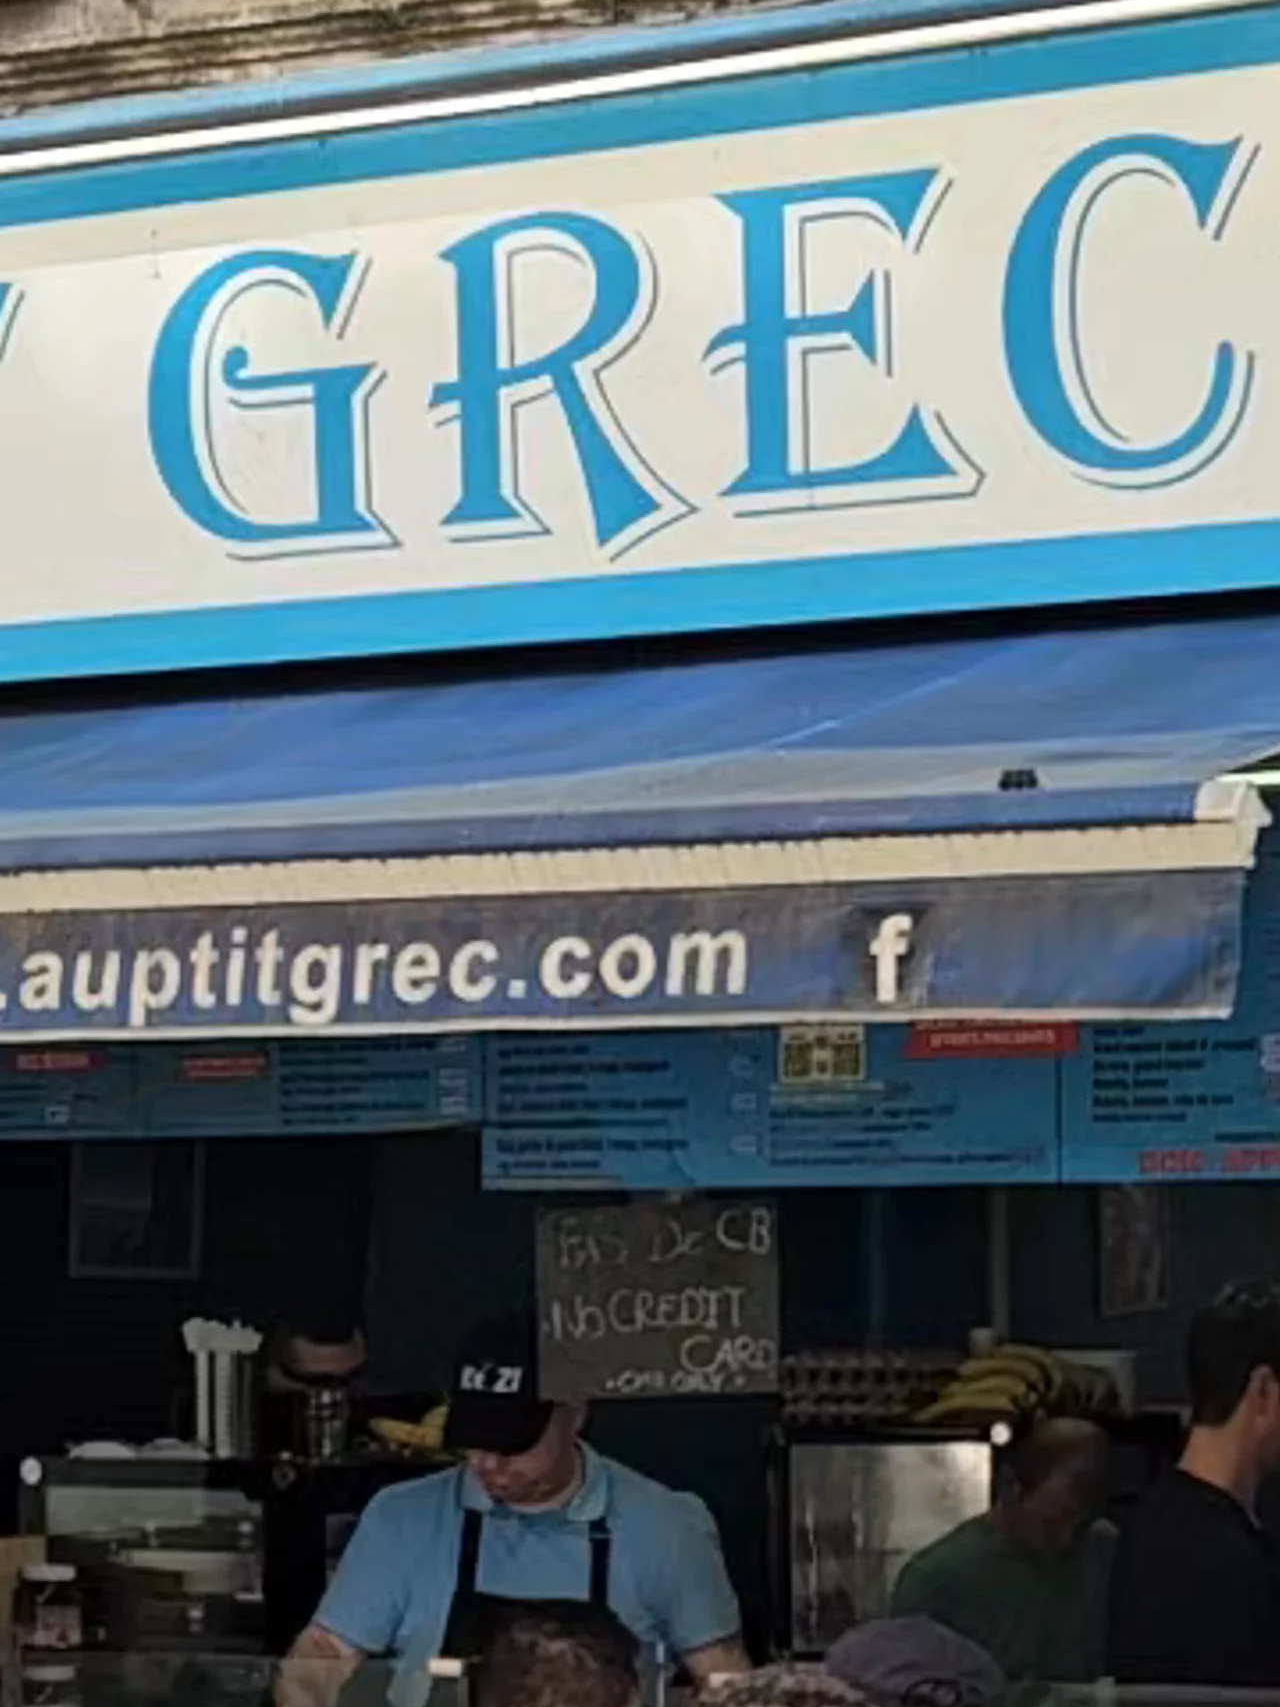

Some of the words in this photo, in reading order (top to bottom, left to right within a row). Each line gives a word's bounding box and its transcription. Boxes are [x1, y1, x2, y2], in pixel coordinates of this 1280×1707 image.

[146, 131, 1262, 563] GREC
[869, 913, 914, 1002] f
[716, 1207, 771, 1254] CB
[608, 1286, 746, 1333] CREDIT
